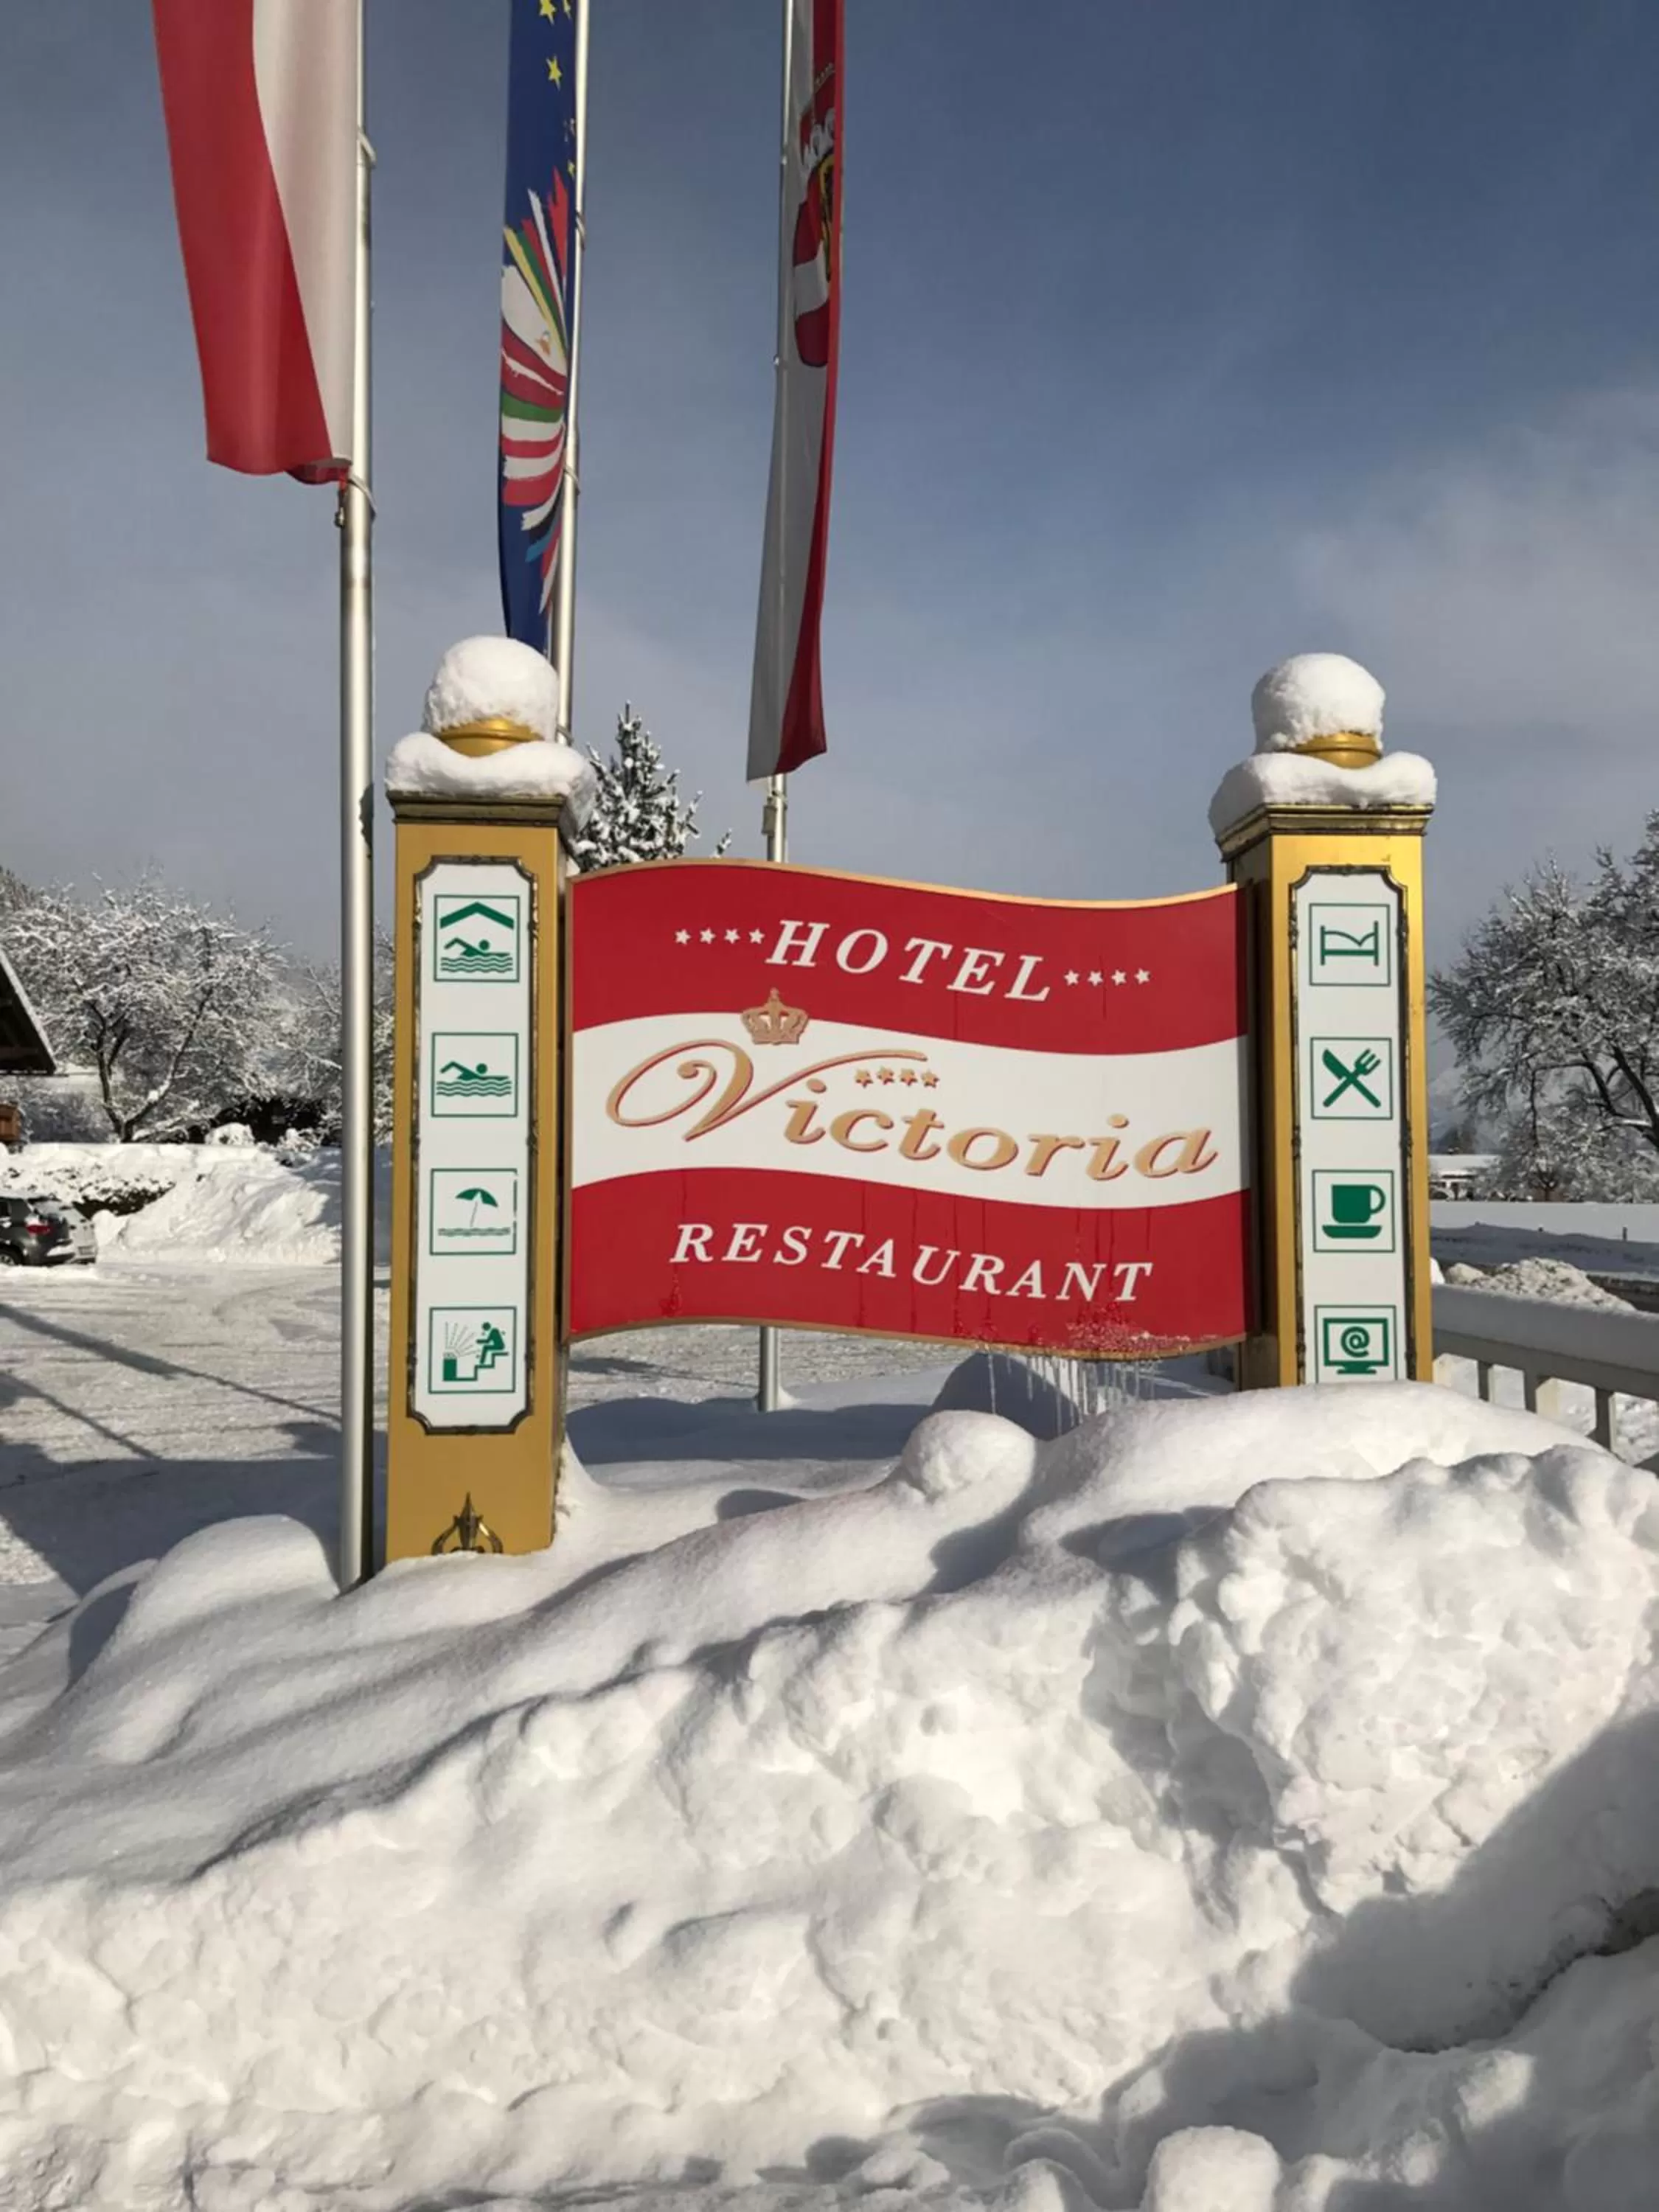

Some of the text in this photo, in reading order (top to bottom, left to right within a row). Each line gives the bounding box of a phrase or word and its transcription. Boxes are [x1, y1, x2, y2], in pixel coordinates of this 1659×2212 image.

[766, 919, 1051, 1002] HOTEL
[605, 1039, 1219, 1180] Victoria
[669, 1223, 1154, 1302] RESTAURANT
